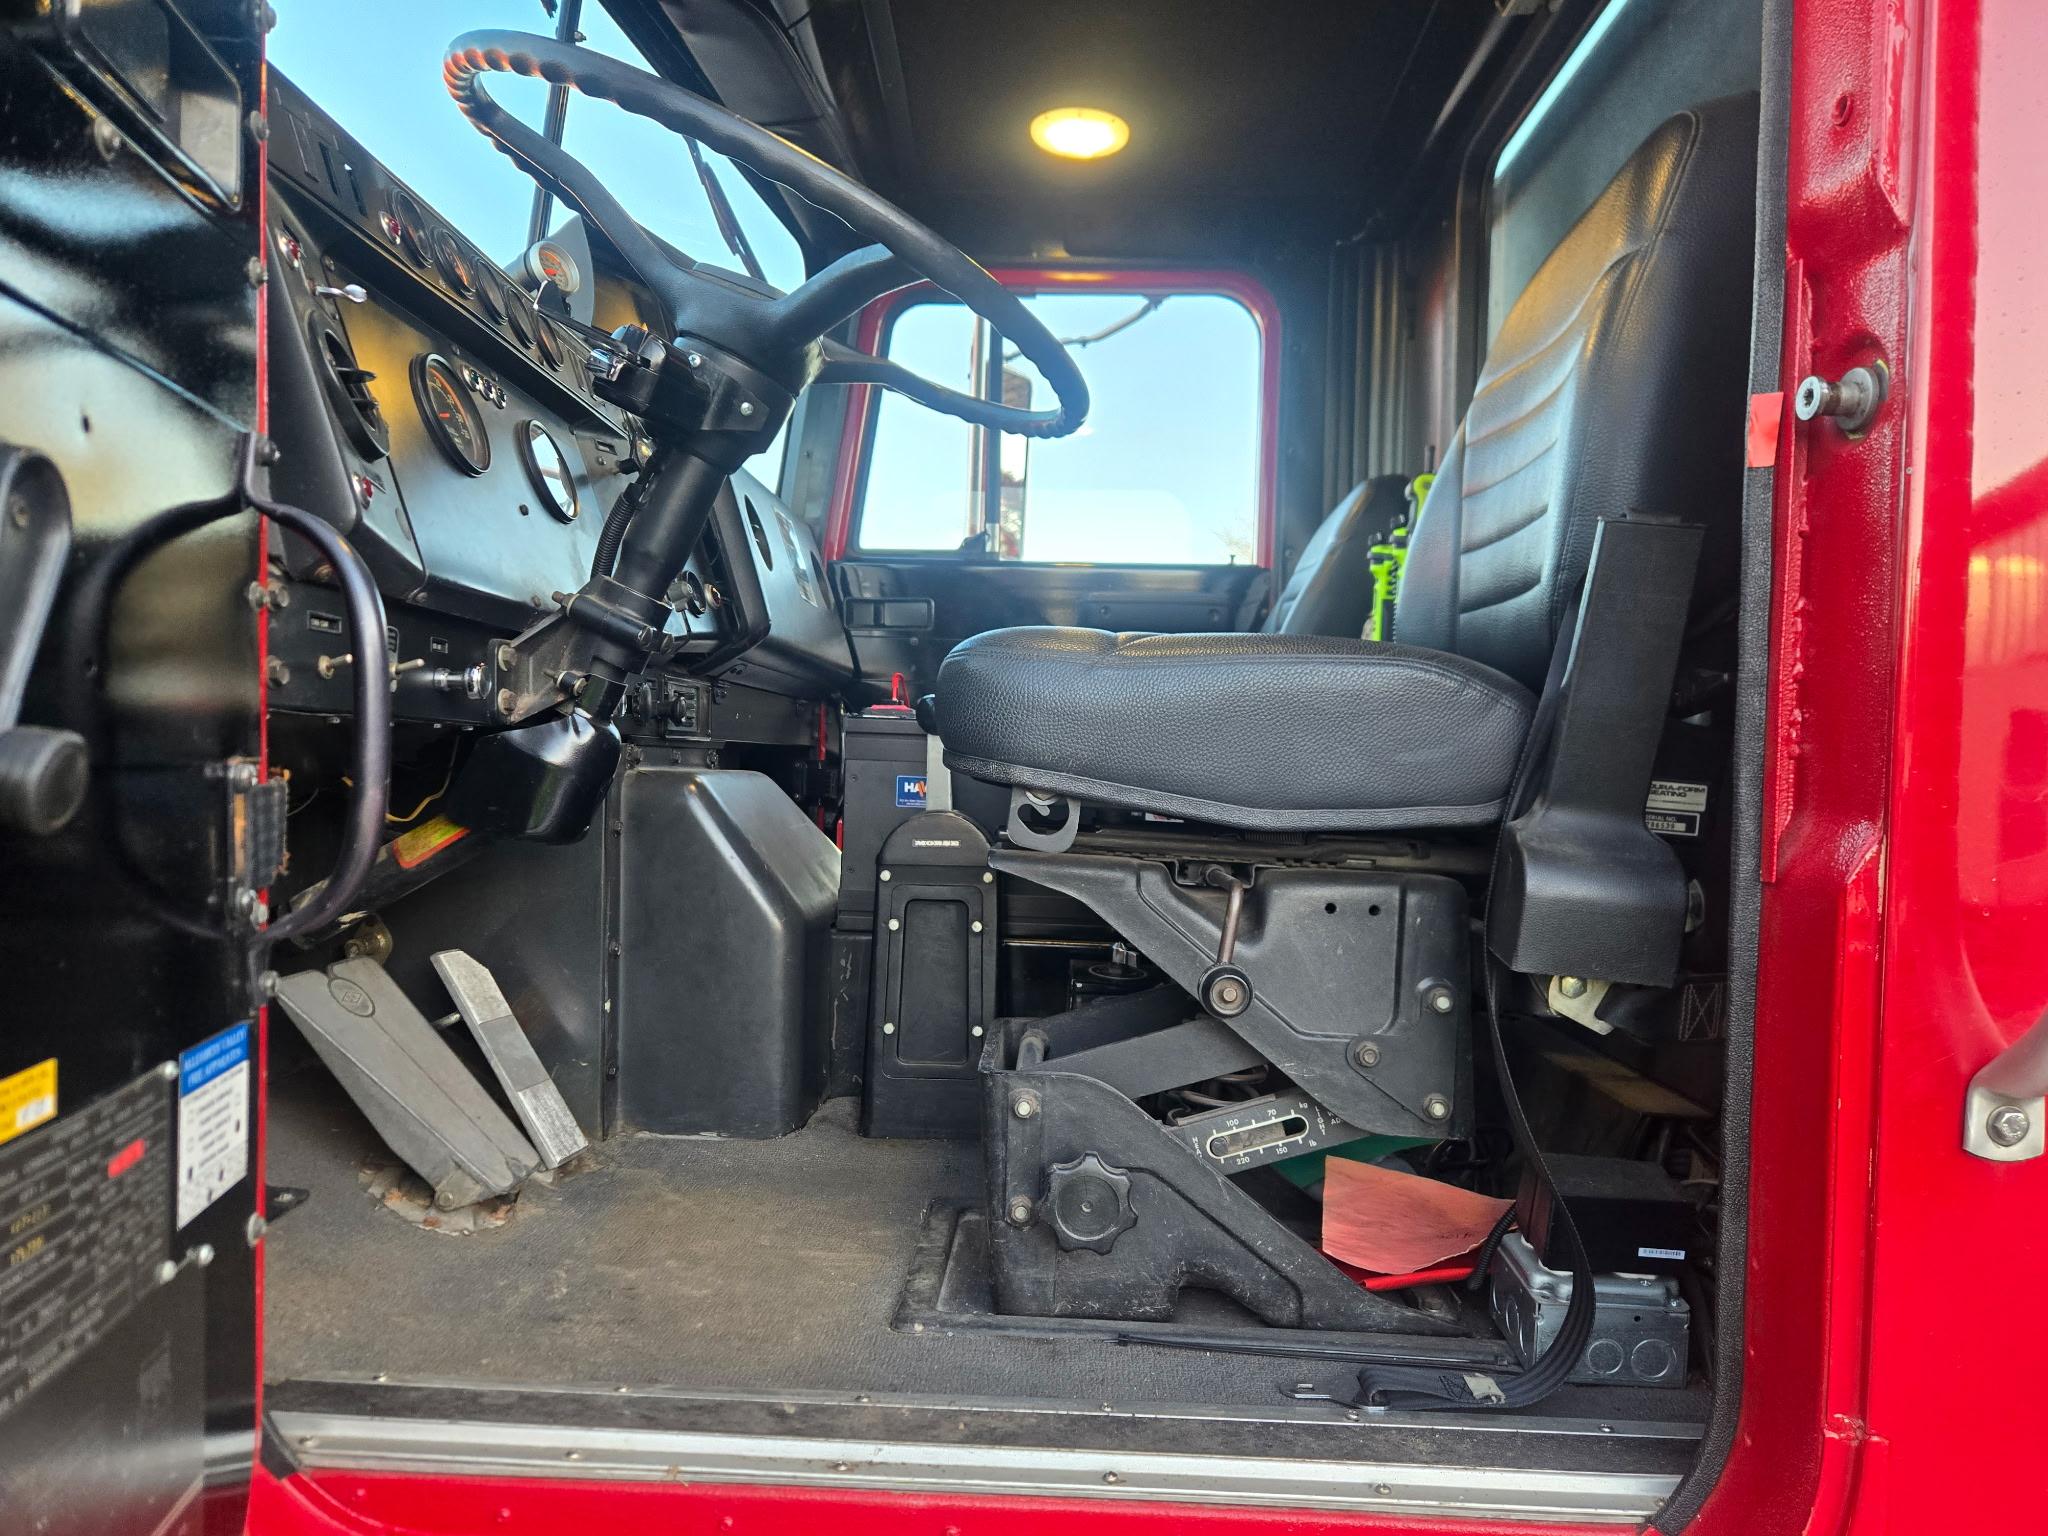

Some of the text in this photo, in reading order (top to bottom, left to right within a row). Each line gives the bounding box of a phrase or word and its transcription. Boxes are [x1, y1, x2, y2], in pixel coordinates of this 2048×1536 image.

[1226, 1119, 1239, 1127] 100
[1267, 1108, 1277, 1117] 70
[1236, 1156, 1251, 1165] 220
[1276, 1146, 1289, 1155] 150
